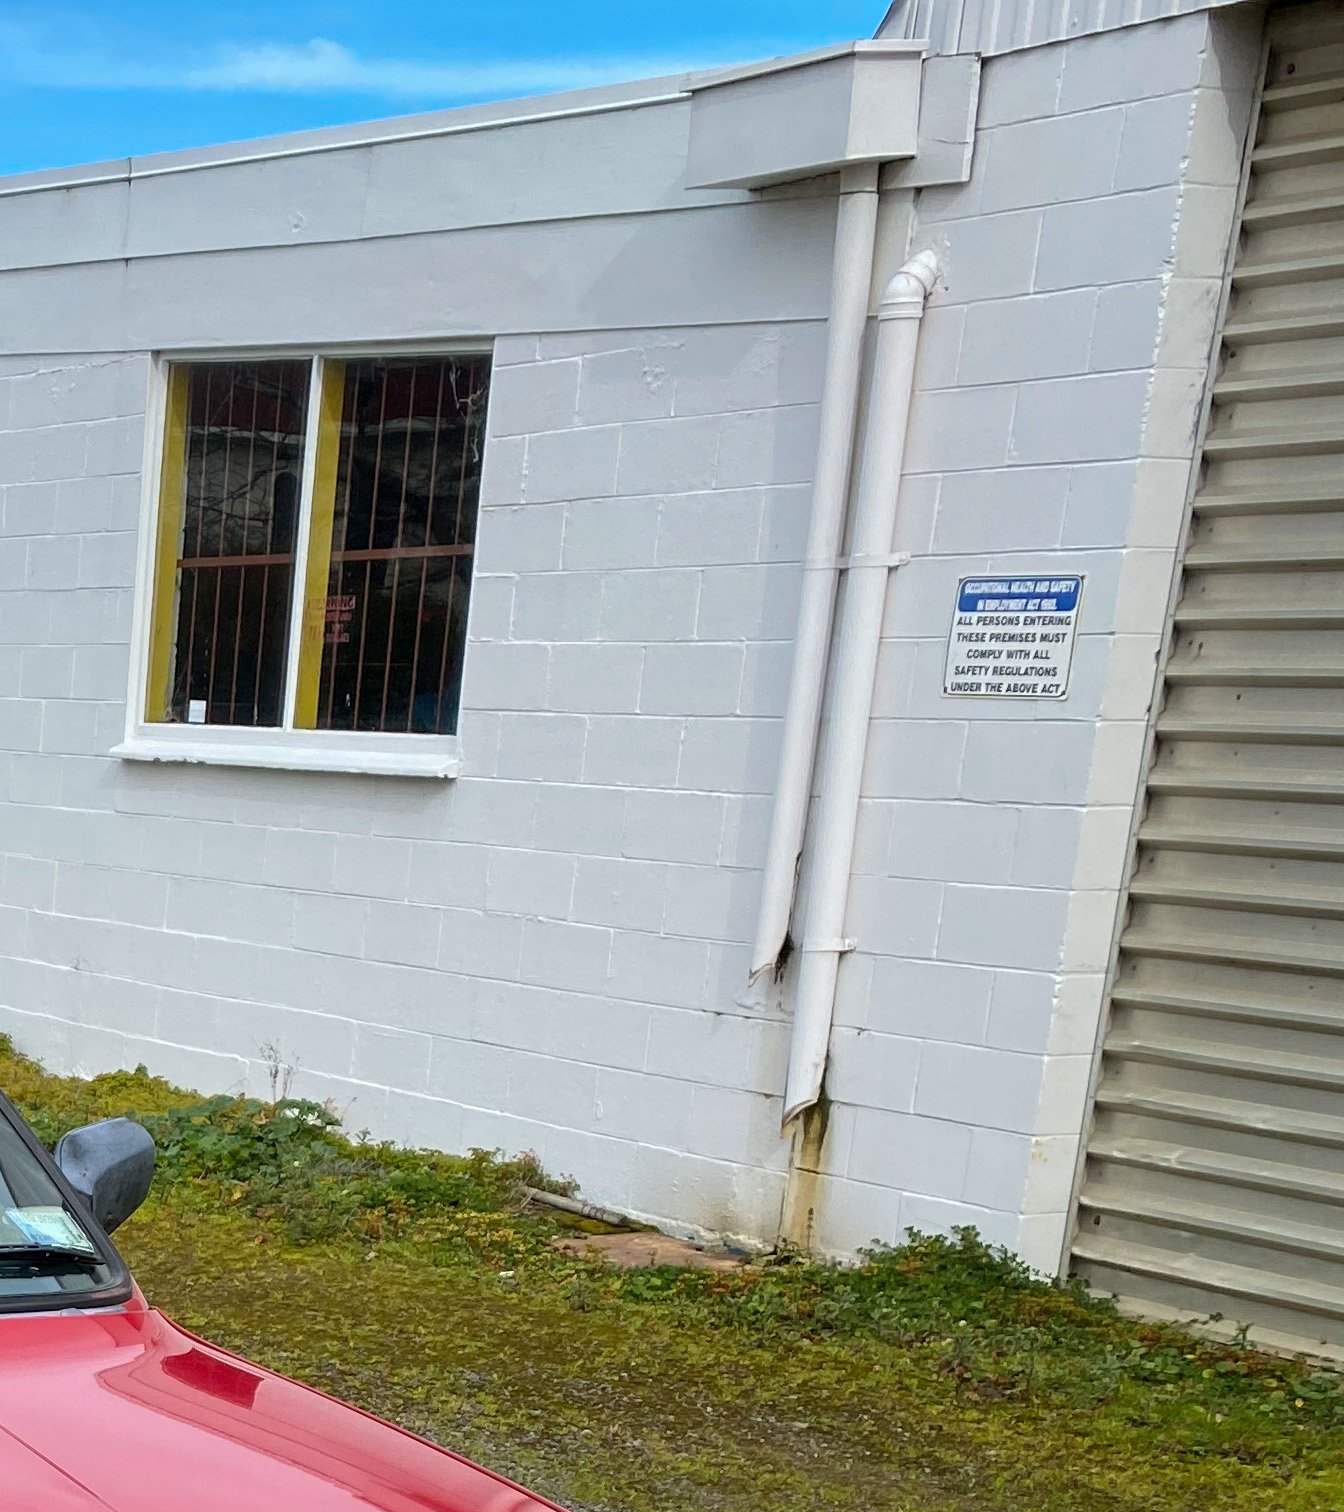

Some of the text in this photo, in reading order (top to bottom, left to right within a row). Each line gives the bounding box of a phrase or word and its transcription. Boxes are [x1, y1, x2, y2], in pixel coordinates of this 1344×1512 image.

[957, 615, 1071, 627] ALL PERSONS ENTERING
[957, 632, 1067, 643] THESE PREMISES MUST
[966, 649, 1050, 660] COMPLY WITH ALL
[955, 666, 1058, 677] SAFETY REGULATIONS
[950, 682, 1060, 694] UNDER THE ABOVE ACT
